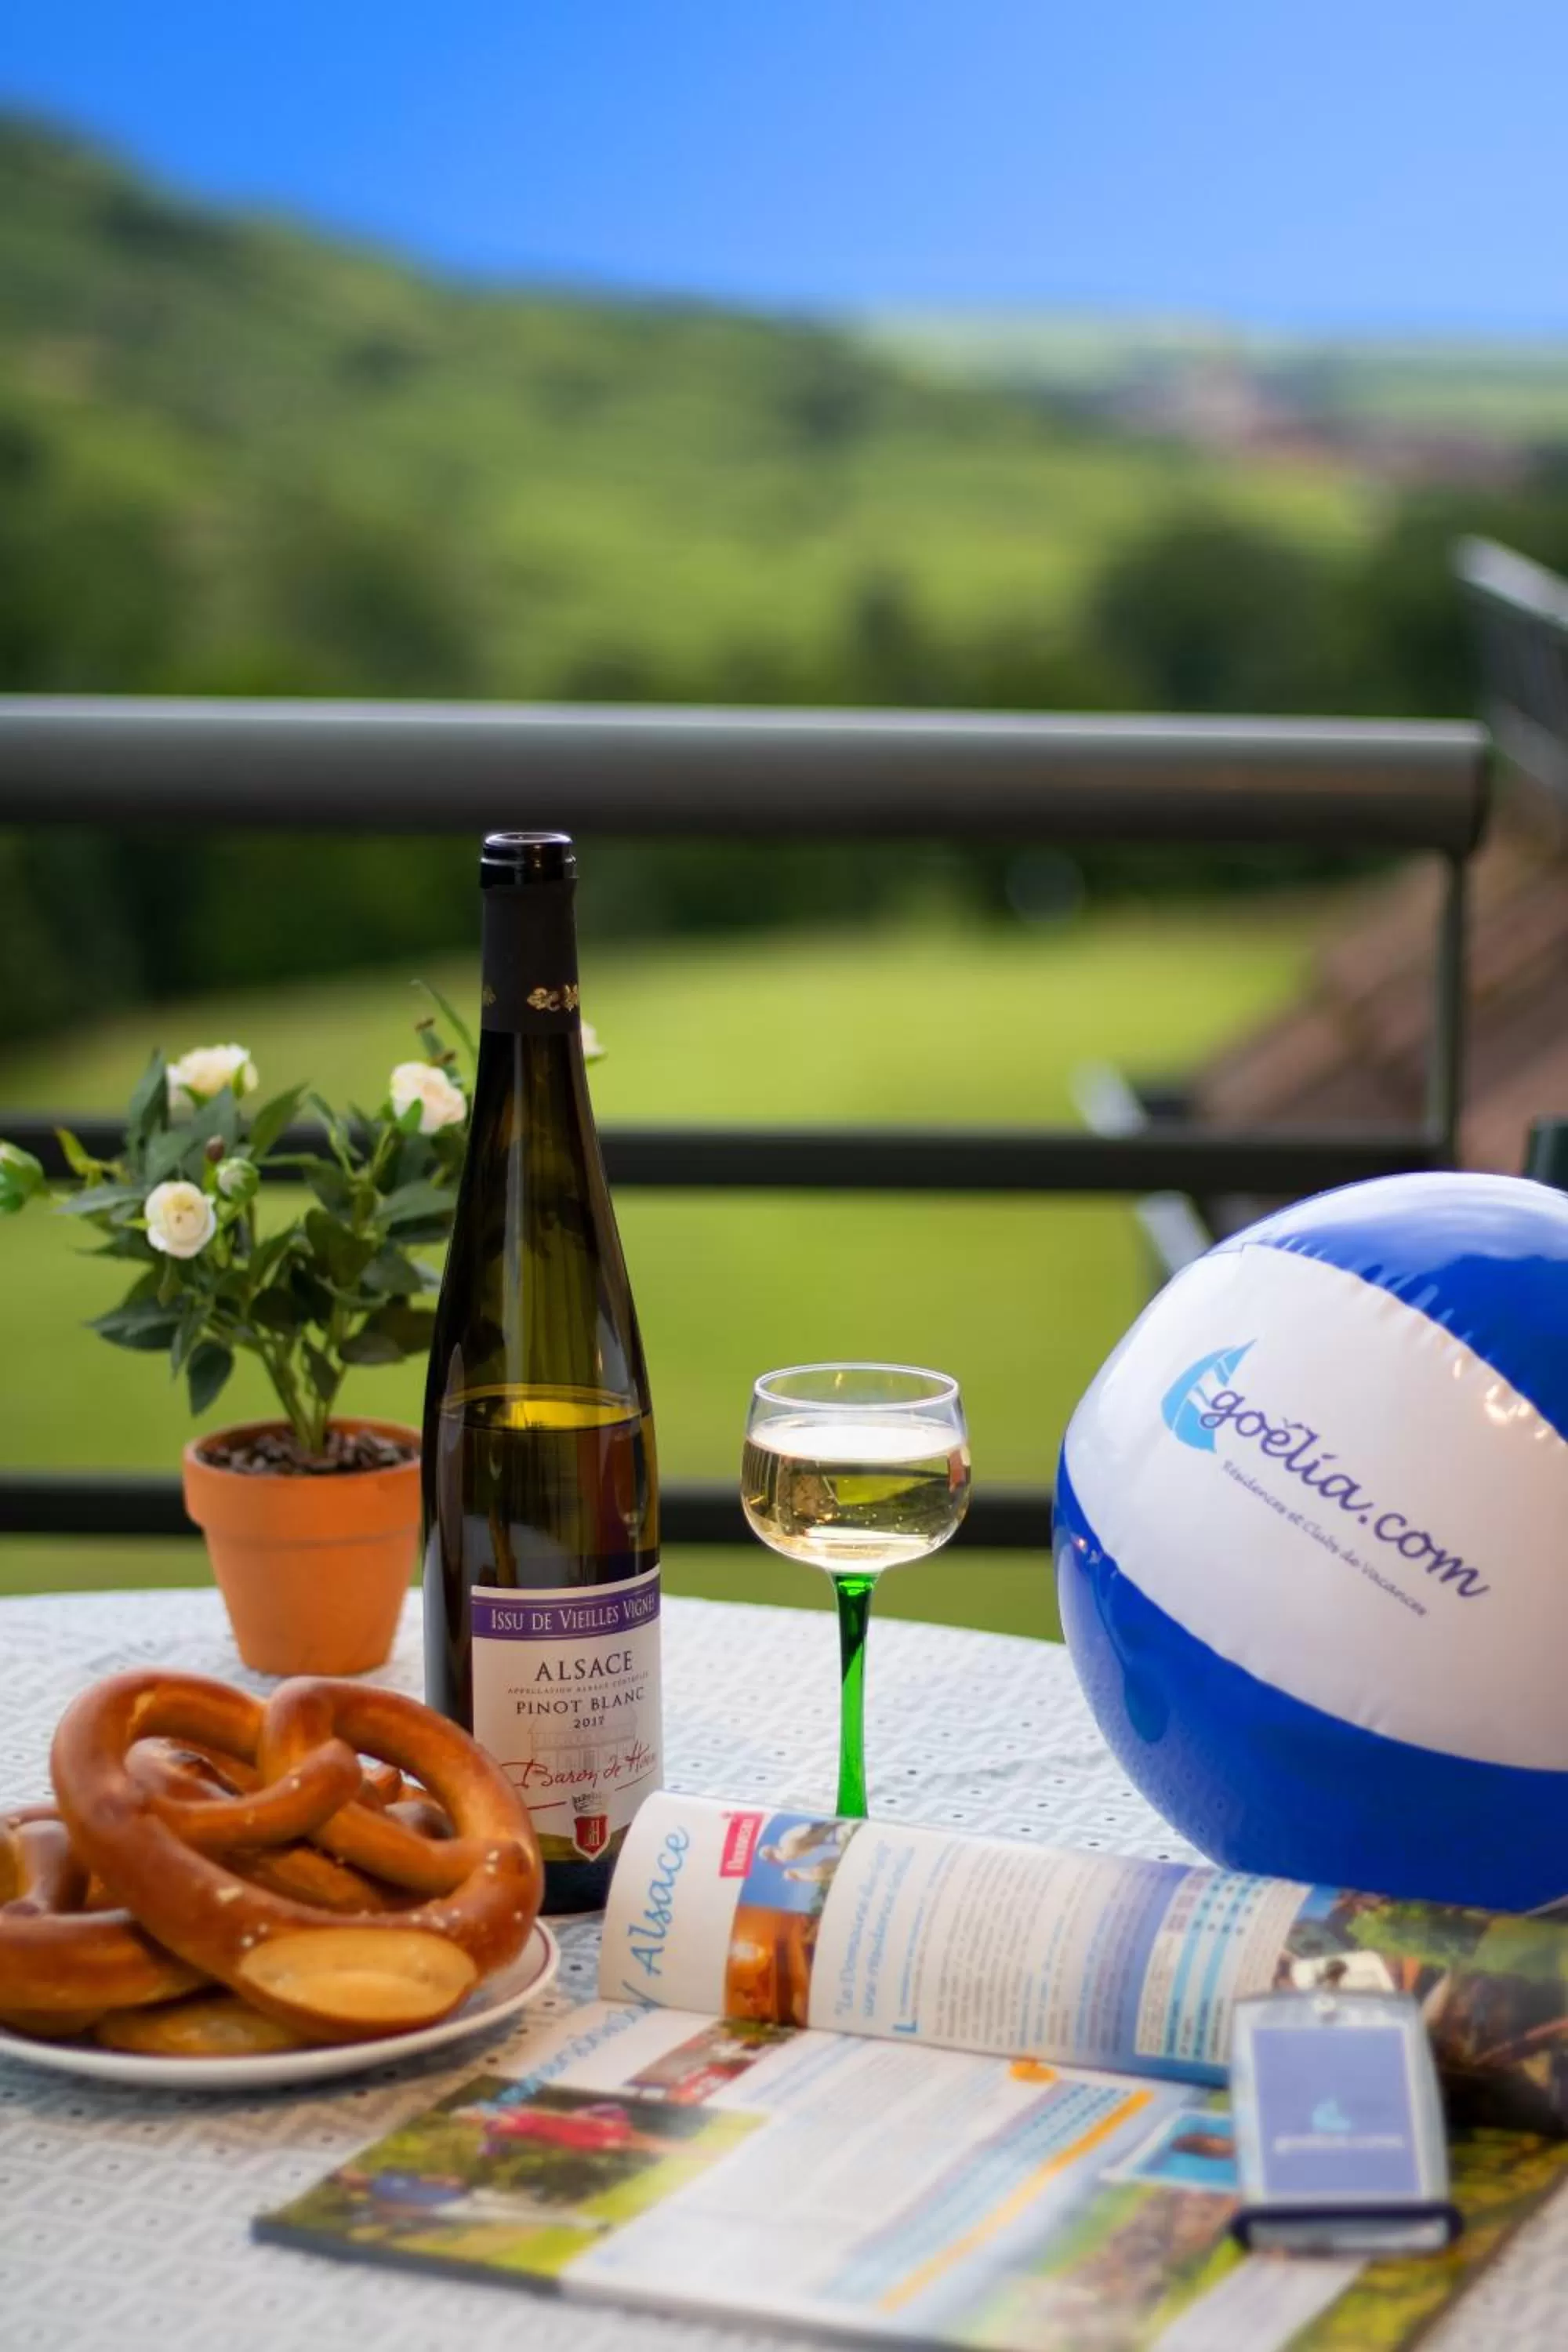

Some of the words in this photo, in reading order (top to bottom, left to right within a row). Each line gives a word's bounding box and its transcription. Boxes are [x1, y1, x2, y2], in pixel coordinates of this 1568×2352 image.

[1287, 1510, 1305, 1526] et
[1302, 1520, 1339, 1555] Clubs
[1339, 1548, 1360, 1567] de
[1361, 1560, 1427, 1617] Vacances
[491, 1608, 524, 1631] ISSU
[532, 1612, 553, 1631] DE
[558, 1604, 619, 1630] VIEILLES
[534, 1650, 633, 1682] ALSACE
[516, 1699, 583, 1716] PINOT
[590, 1686, 645, 1712] BLANC
[573, 1715, 605, 1730] 2017
[626, 1824, 690, 1977] Alsace
